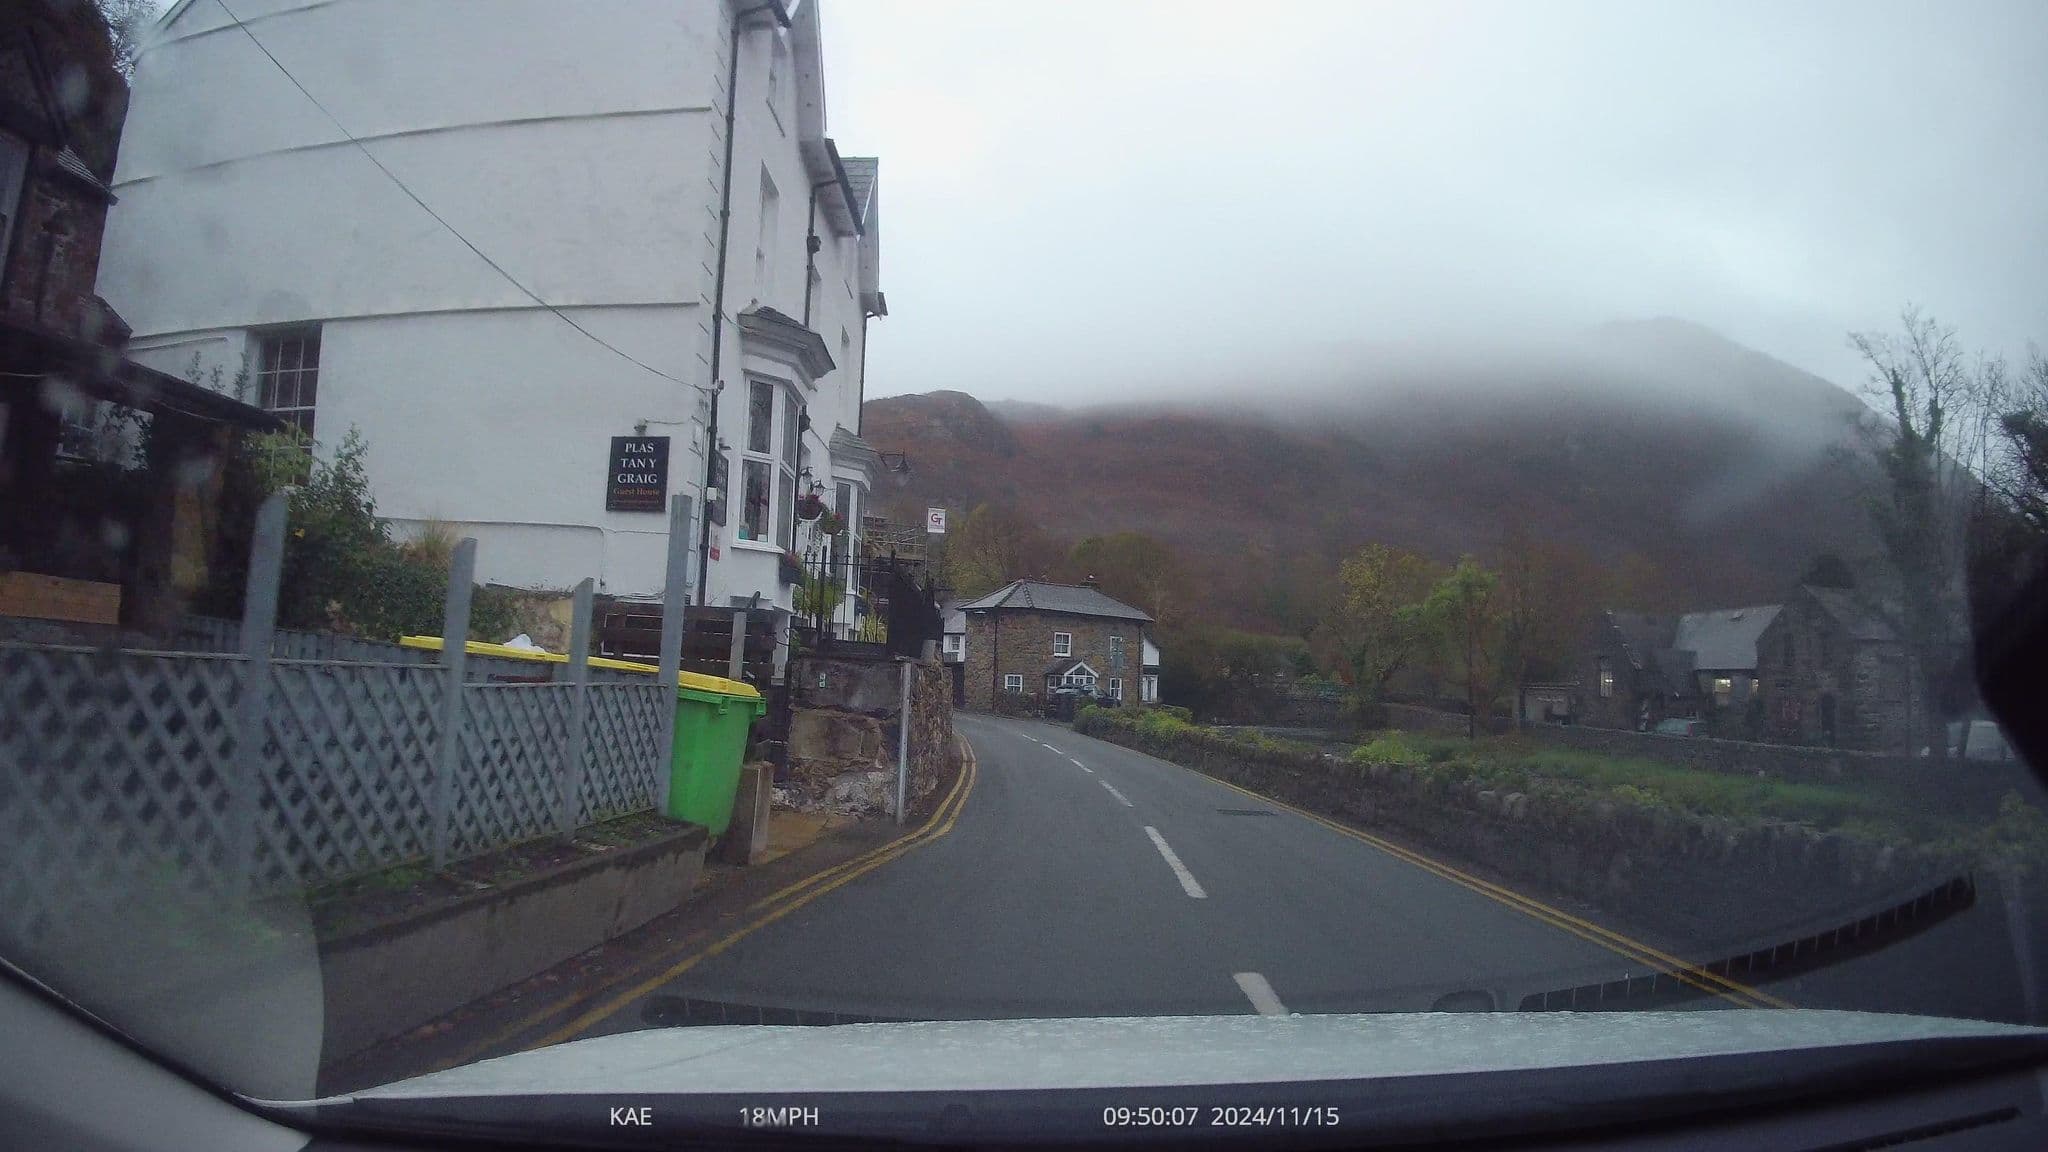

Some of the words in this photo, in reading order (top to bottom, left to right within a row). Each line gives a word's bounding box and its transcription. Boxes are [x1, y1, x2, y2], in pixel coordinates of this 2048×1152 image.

[625, 442, 654, 453] PLAS
[620, 458, 646, 469] TAN
[649, 458, 656, 469] Y
[617, 473, 658, 484] GRAIG
[613, 487, 635, 497] Guest
[637, 487, 660, 497] House
